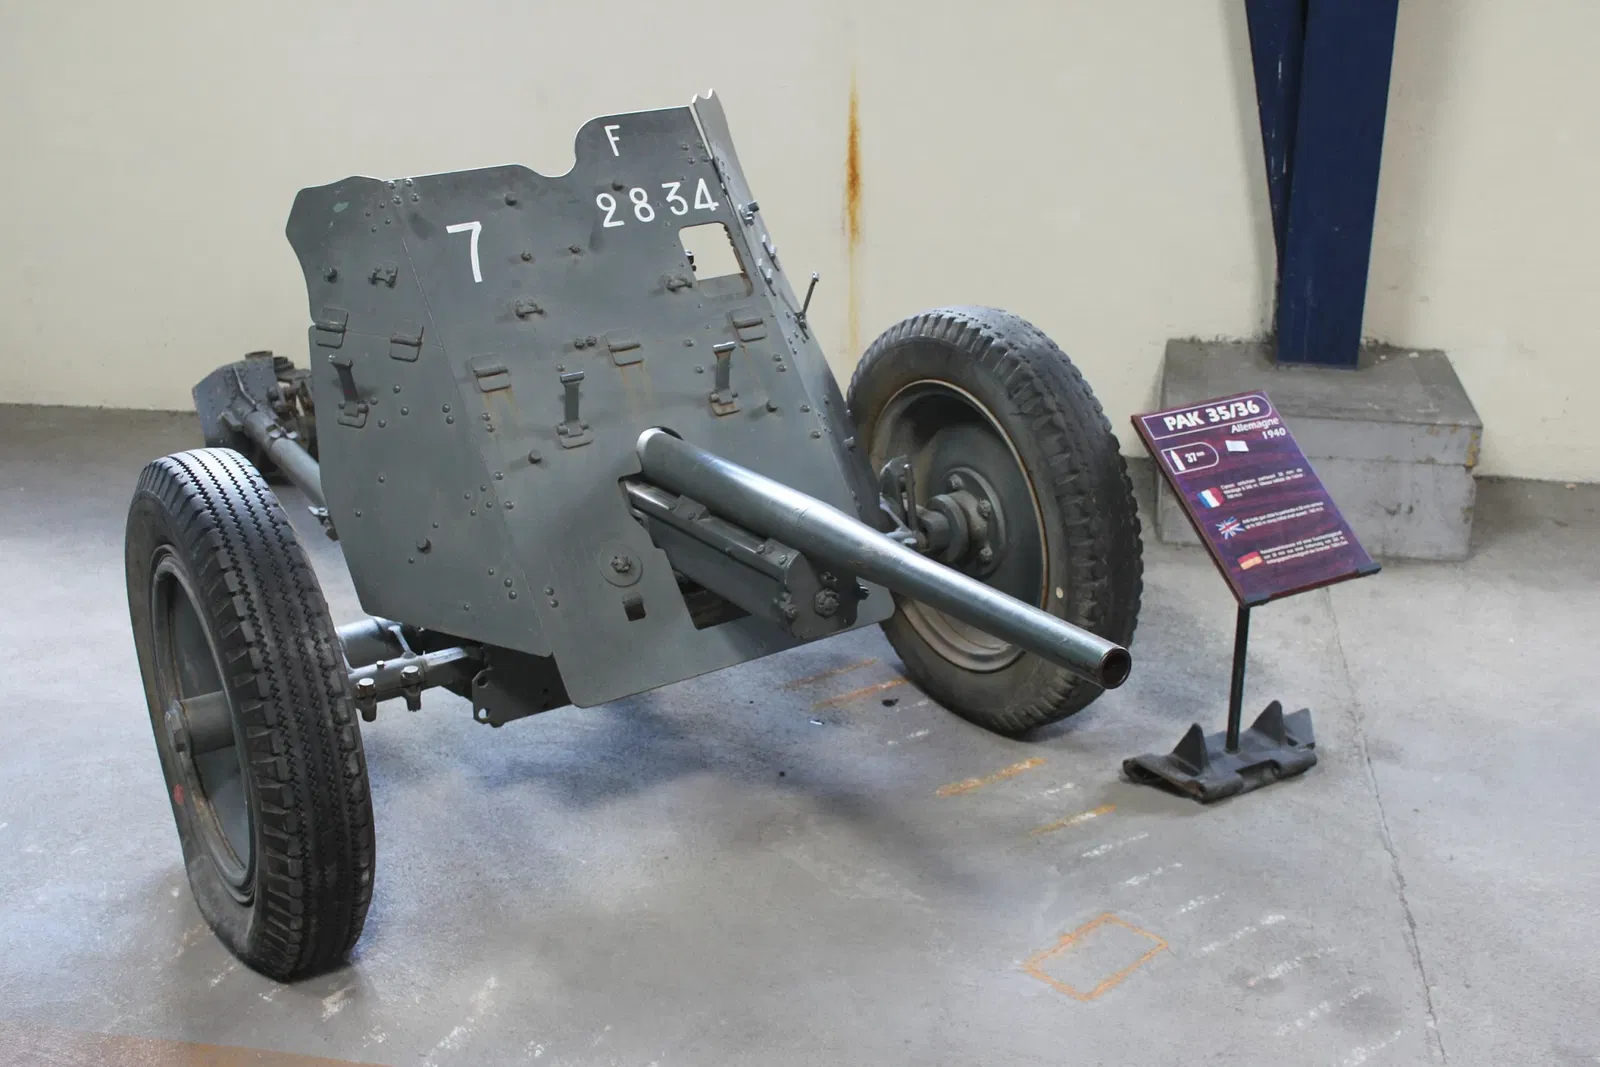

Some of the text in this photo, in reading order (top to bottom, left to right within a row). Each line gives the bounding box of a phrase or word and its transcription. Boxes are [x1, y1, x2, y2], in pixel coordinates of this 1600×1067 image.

[604, 124, 620, 157] F
[595, 178, 720, 228] 2834
[446, 221, 483, 283] 7
[1163, 400, 1260, 431] PAK 35/36
[1231, 416, 1280, 434] Allemagne
[1262, 427, 1287, 440] 1940
